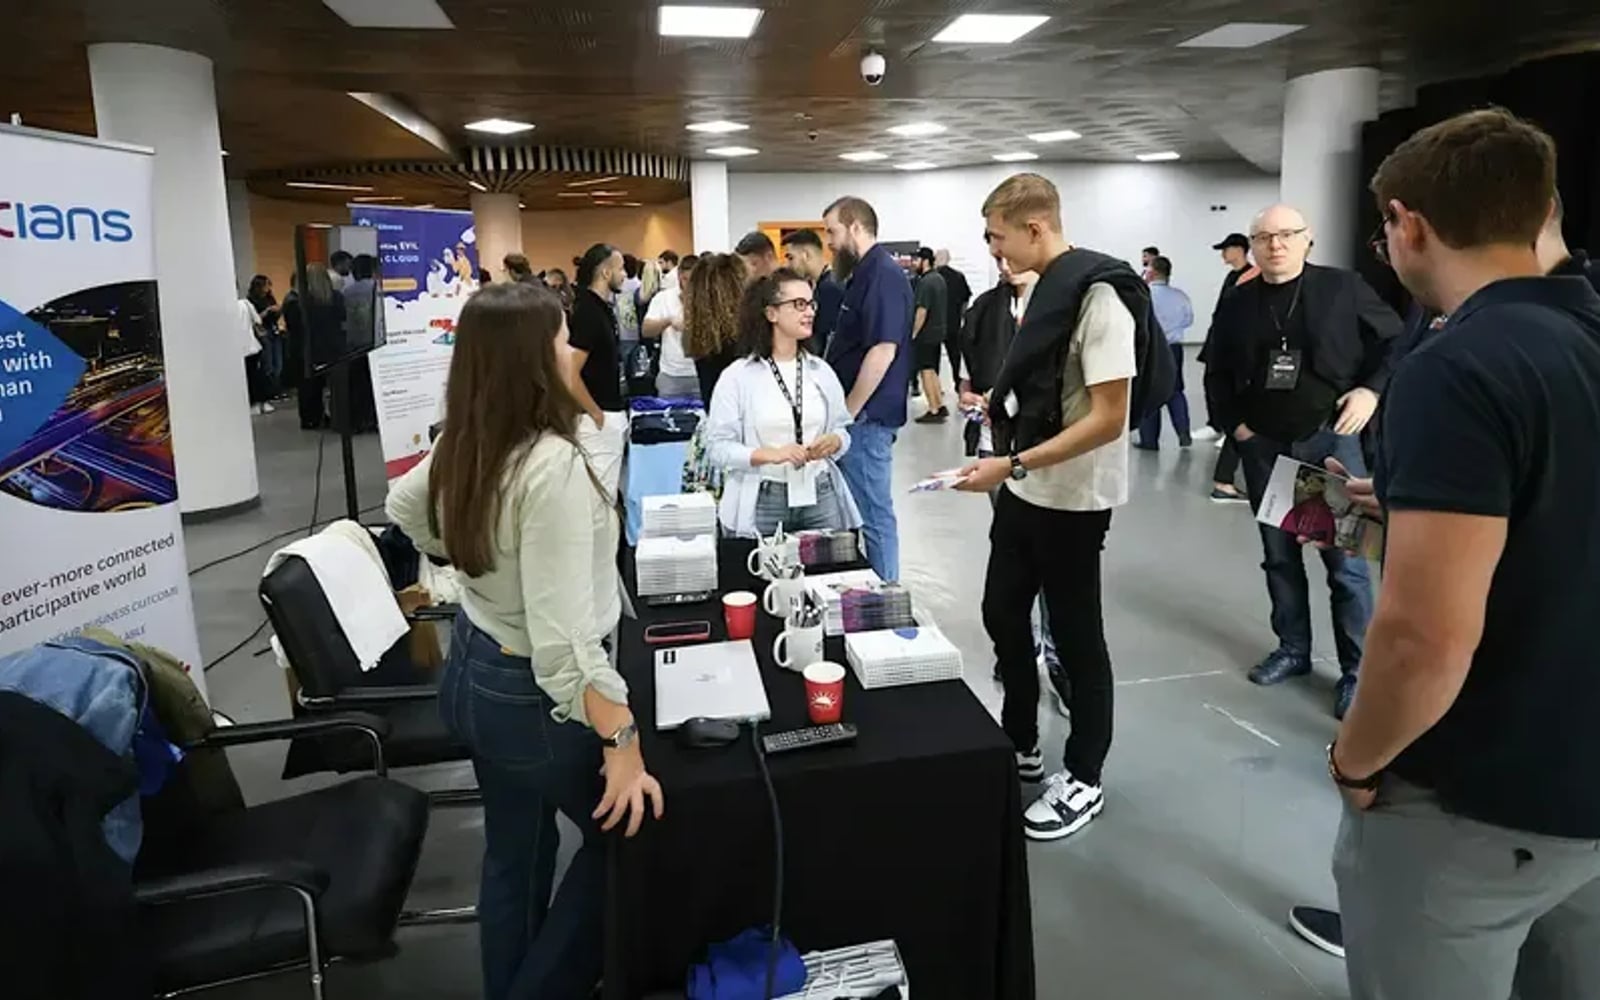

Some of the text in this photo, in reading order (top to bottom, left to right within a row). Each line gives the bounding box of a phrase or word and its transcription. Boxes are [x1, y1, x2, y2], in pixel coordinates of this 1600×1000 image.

[384, 254, 419, 263] CLOUD
[3, 350, 52, 373] with
[2, 533, 176, 607] ever-more connected
[0, 563, 147, 633] participative world
